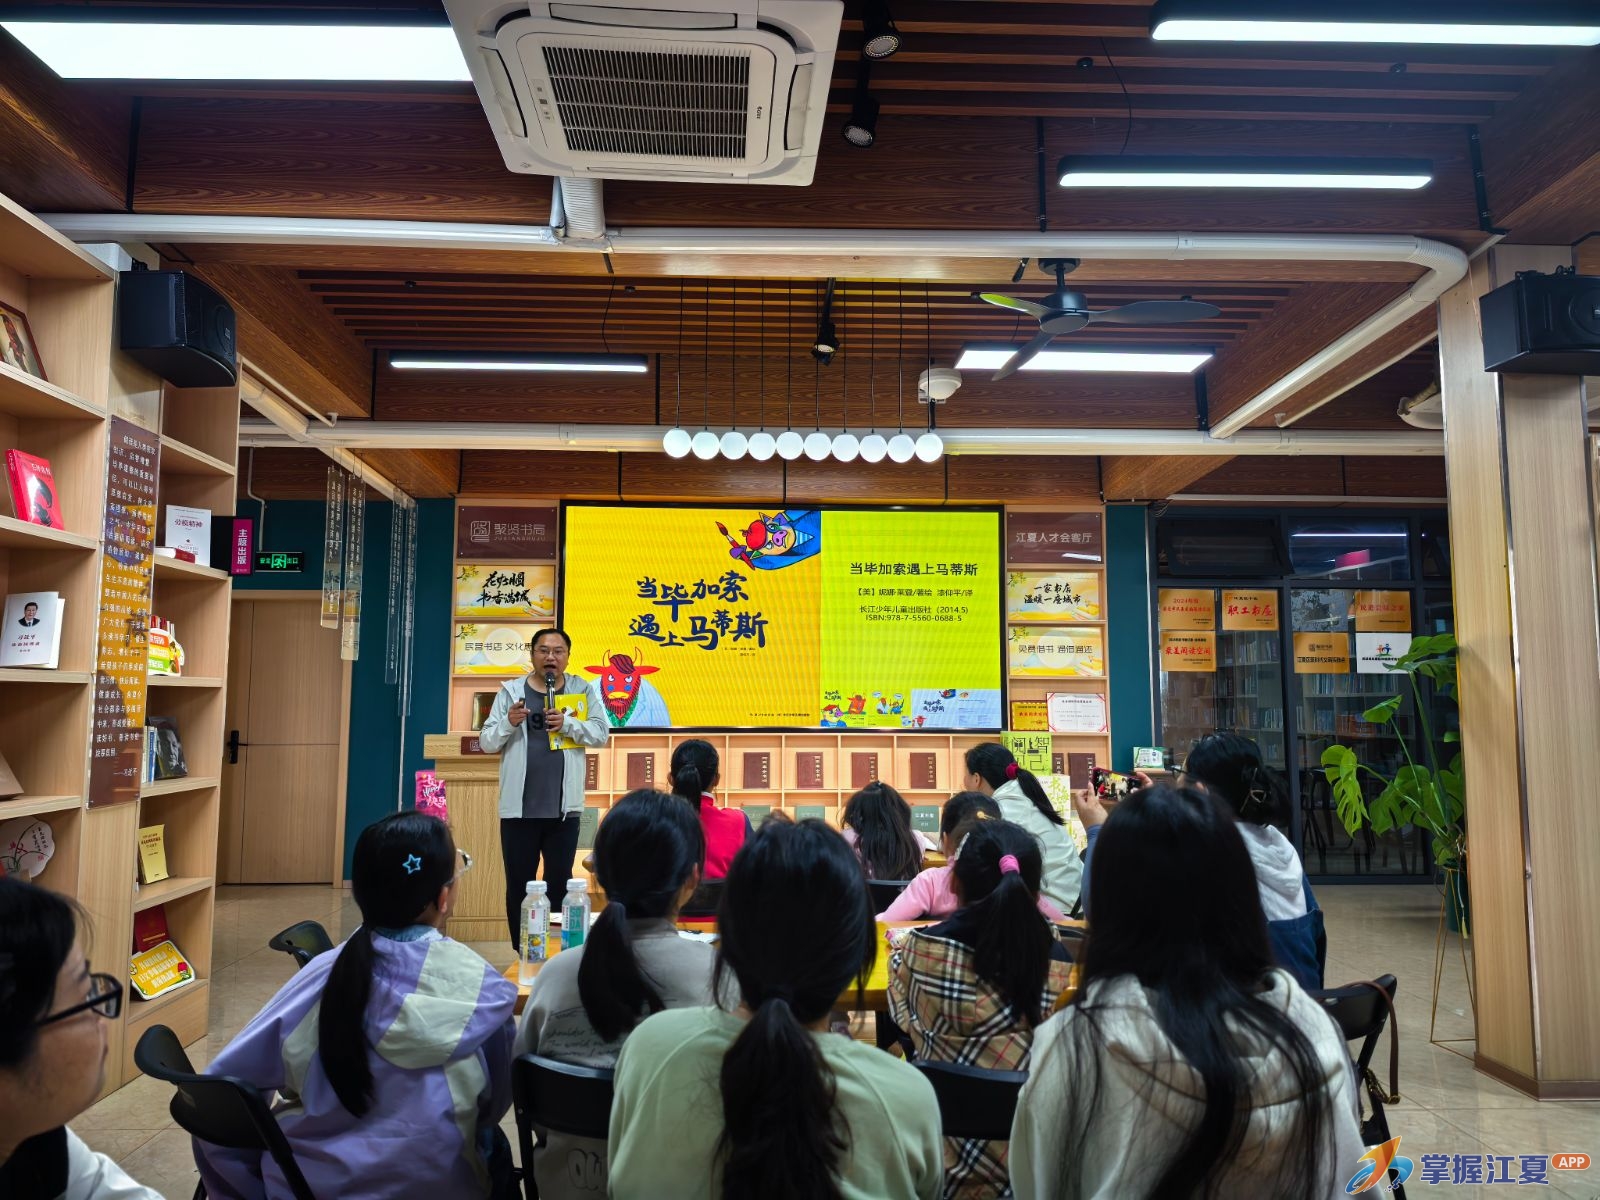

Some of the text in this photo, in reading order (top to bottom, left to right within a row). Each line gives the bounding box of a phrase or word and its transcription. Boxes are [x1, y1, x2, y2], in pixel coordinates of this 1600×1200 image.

[494, 523, 546, 536] 聚贤书局
[1015, 531, 1093, 544] 江夏人才会客厅
[237, 529, 248, 564] 主题出版
[850, 563, 978, 576] 当毕加索遇上马蒂斯
[1034, 583, 1071, 594] 一家书店
[636, 570, 749, 622] 当毕加索
[1024, 594, 1082, 605] 温暖一座城市
[1227, 604, 1273, 617] 职工书屋
[628, 609, 769, 649] 遇上马蒂斯
[465, 642, 503, 652] 民营书店
[1018, 644, 1093, 654] 免费借书 通借通还
[1165, 646, 1211, 656] 最美阅读空间
